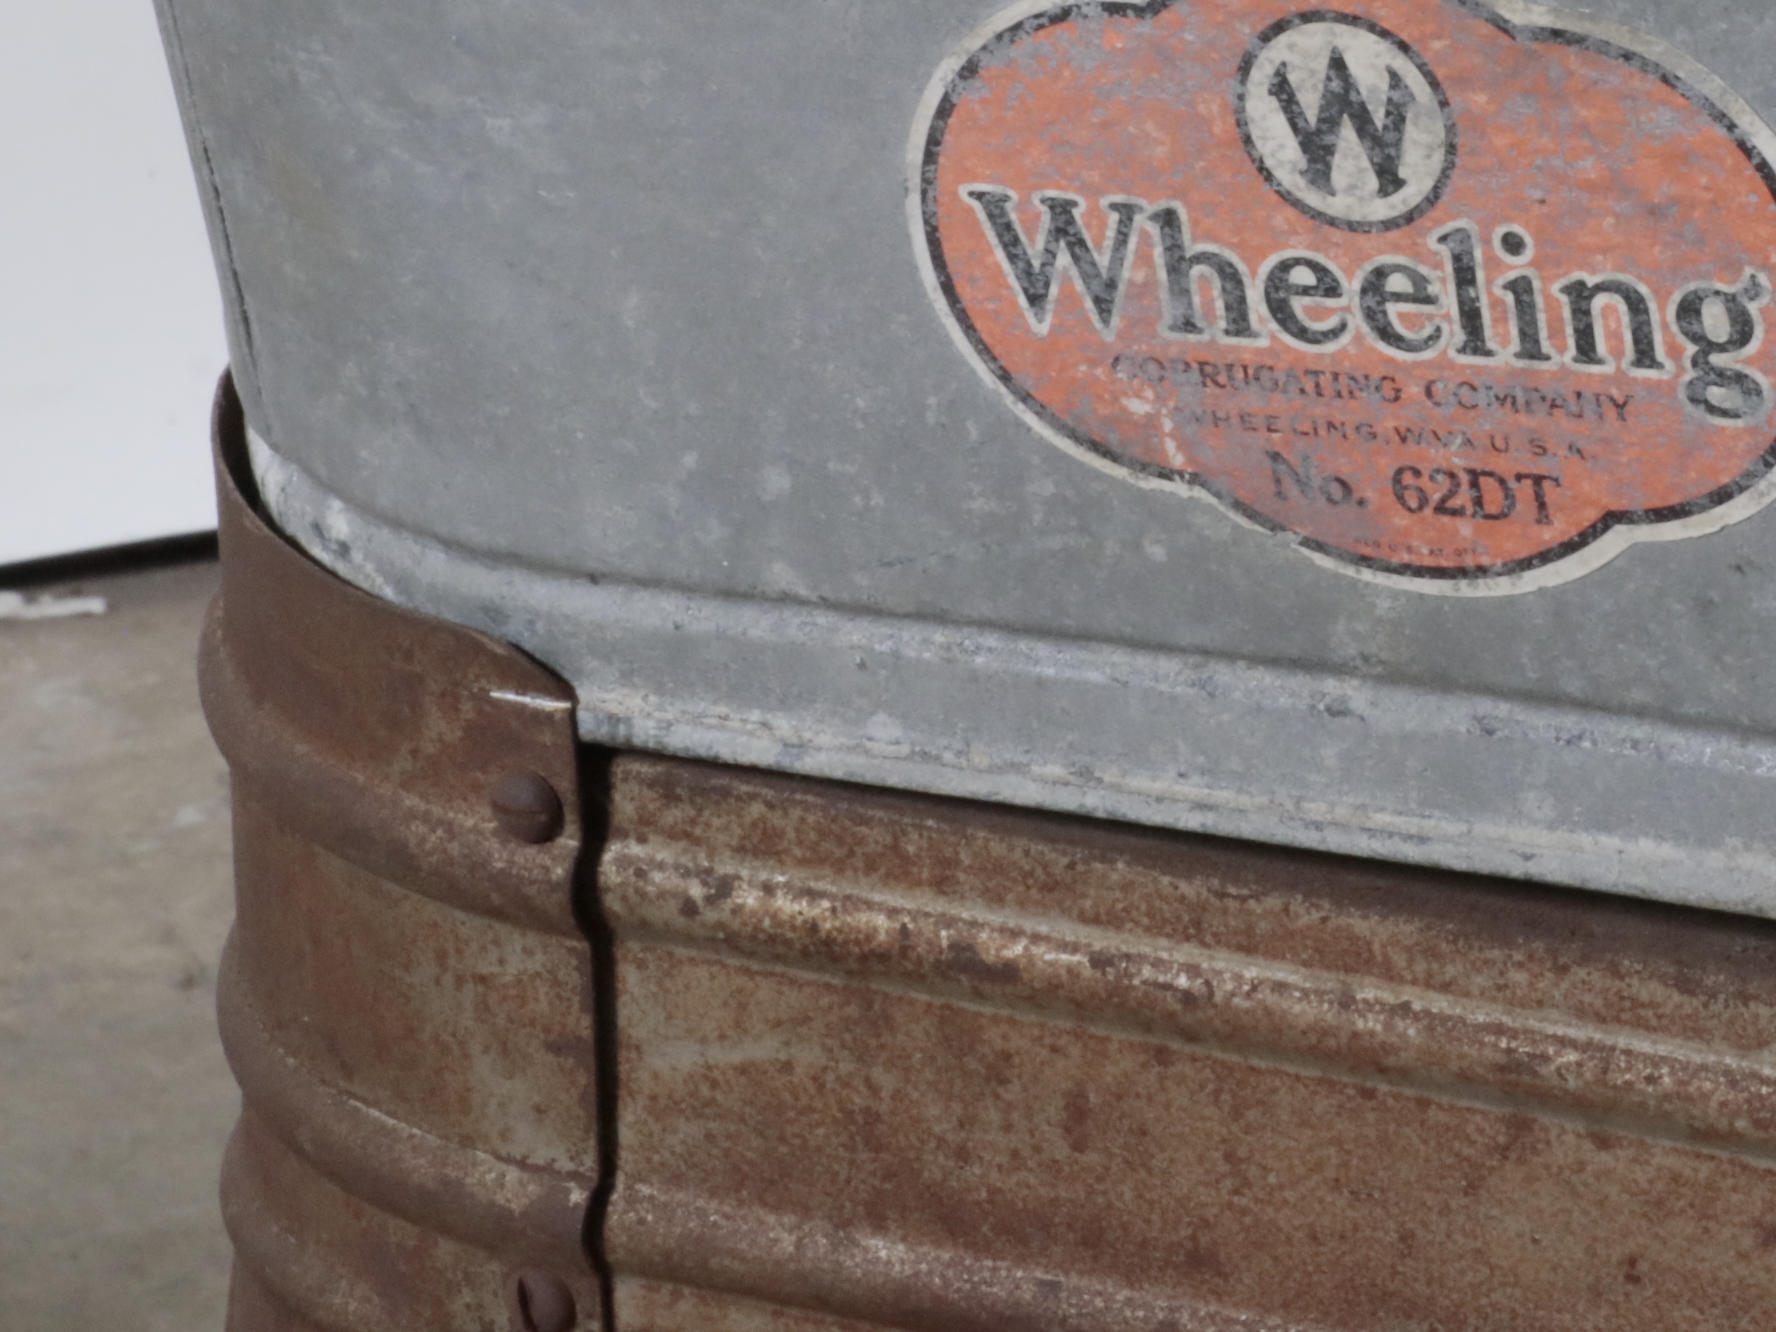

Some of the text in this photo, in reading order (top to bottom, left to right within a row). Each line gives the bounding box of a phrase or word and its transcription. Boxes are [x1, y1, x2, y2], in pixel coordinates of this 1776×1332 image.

[1267, 44, 1417, 199] W
[960, 184, 1770, 424] Wheeling
[1111, 355, 1634, 422] CORRUGATING COMPANY
[1265, 449, 1561, 525] No. 62DT
